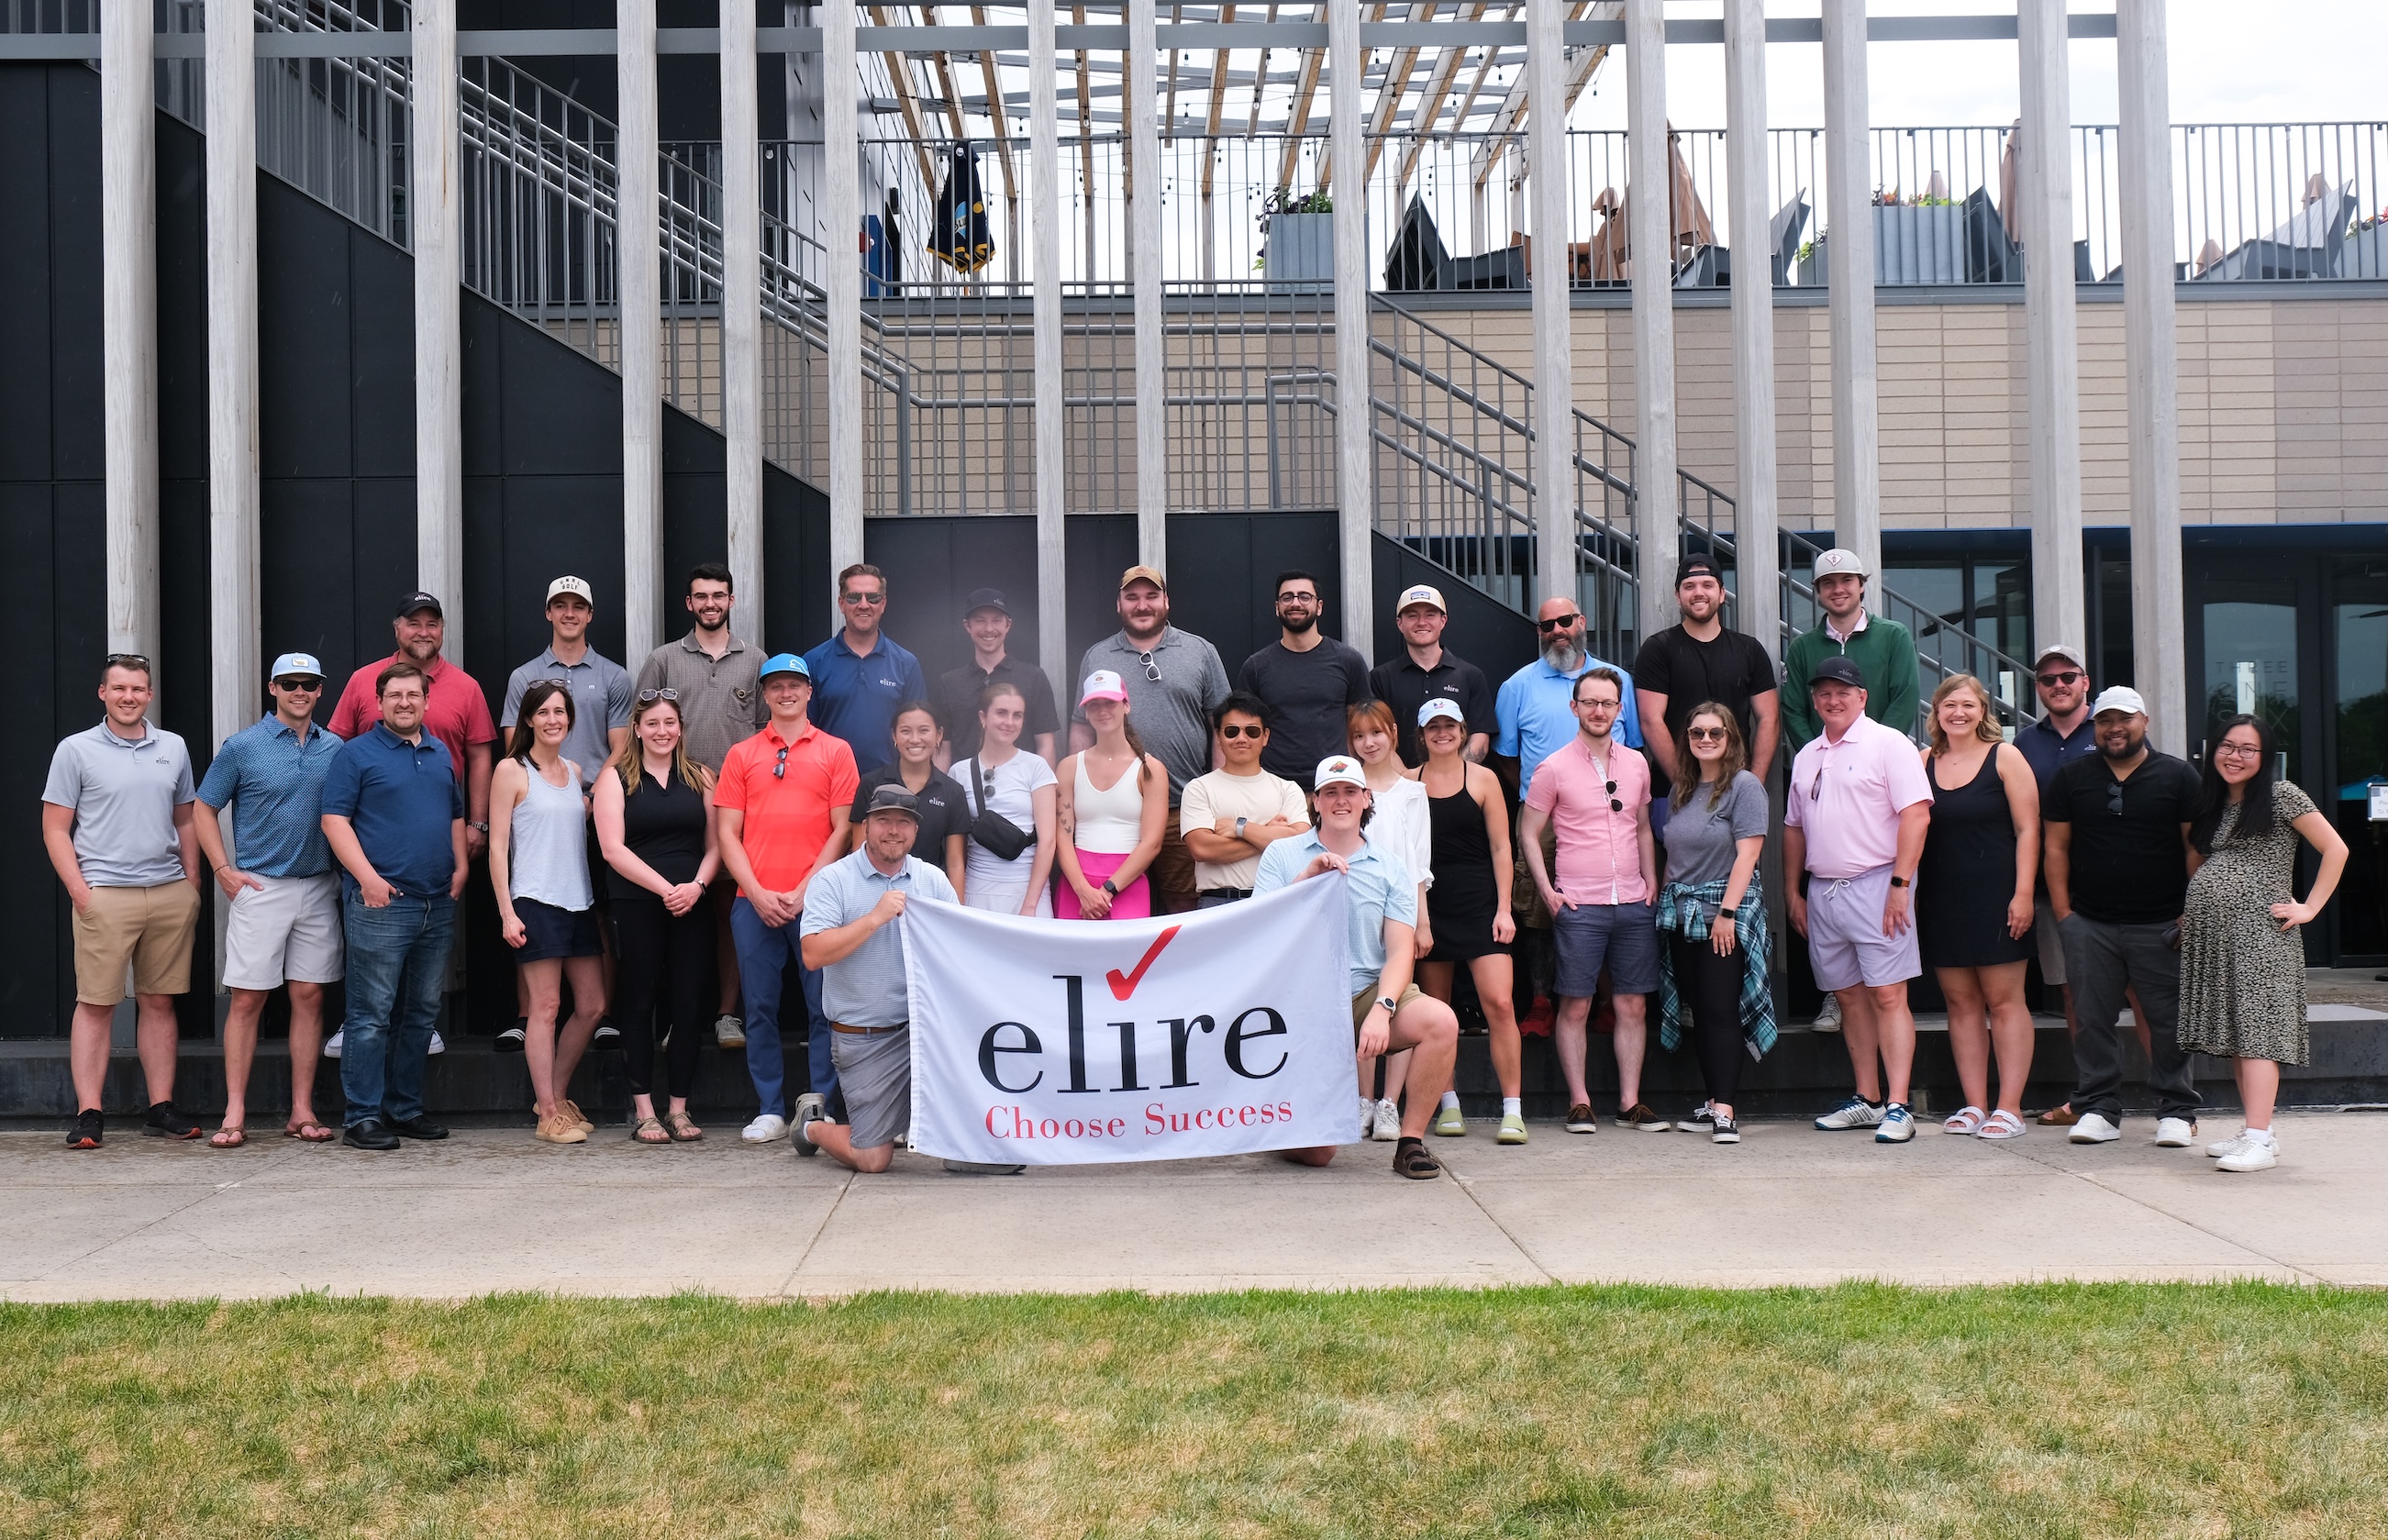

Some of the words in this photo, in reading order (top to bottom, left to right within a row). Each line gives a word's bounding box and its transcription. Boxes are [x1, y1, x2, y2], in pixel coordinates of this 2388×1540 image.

[2216, 660, 2288, 673] THREE
[880, 677, 896, 686] elire
[1444, 683, 1459, 692] elire
[155, 756, 170, 764] elire
[928, 796, 945, 806] elire
[978, 972, 1289, 1094] elire
[984, 1104, 1127, 1140] Choose
[1144, 1100, 1294, 1136] Success
